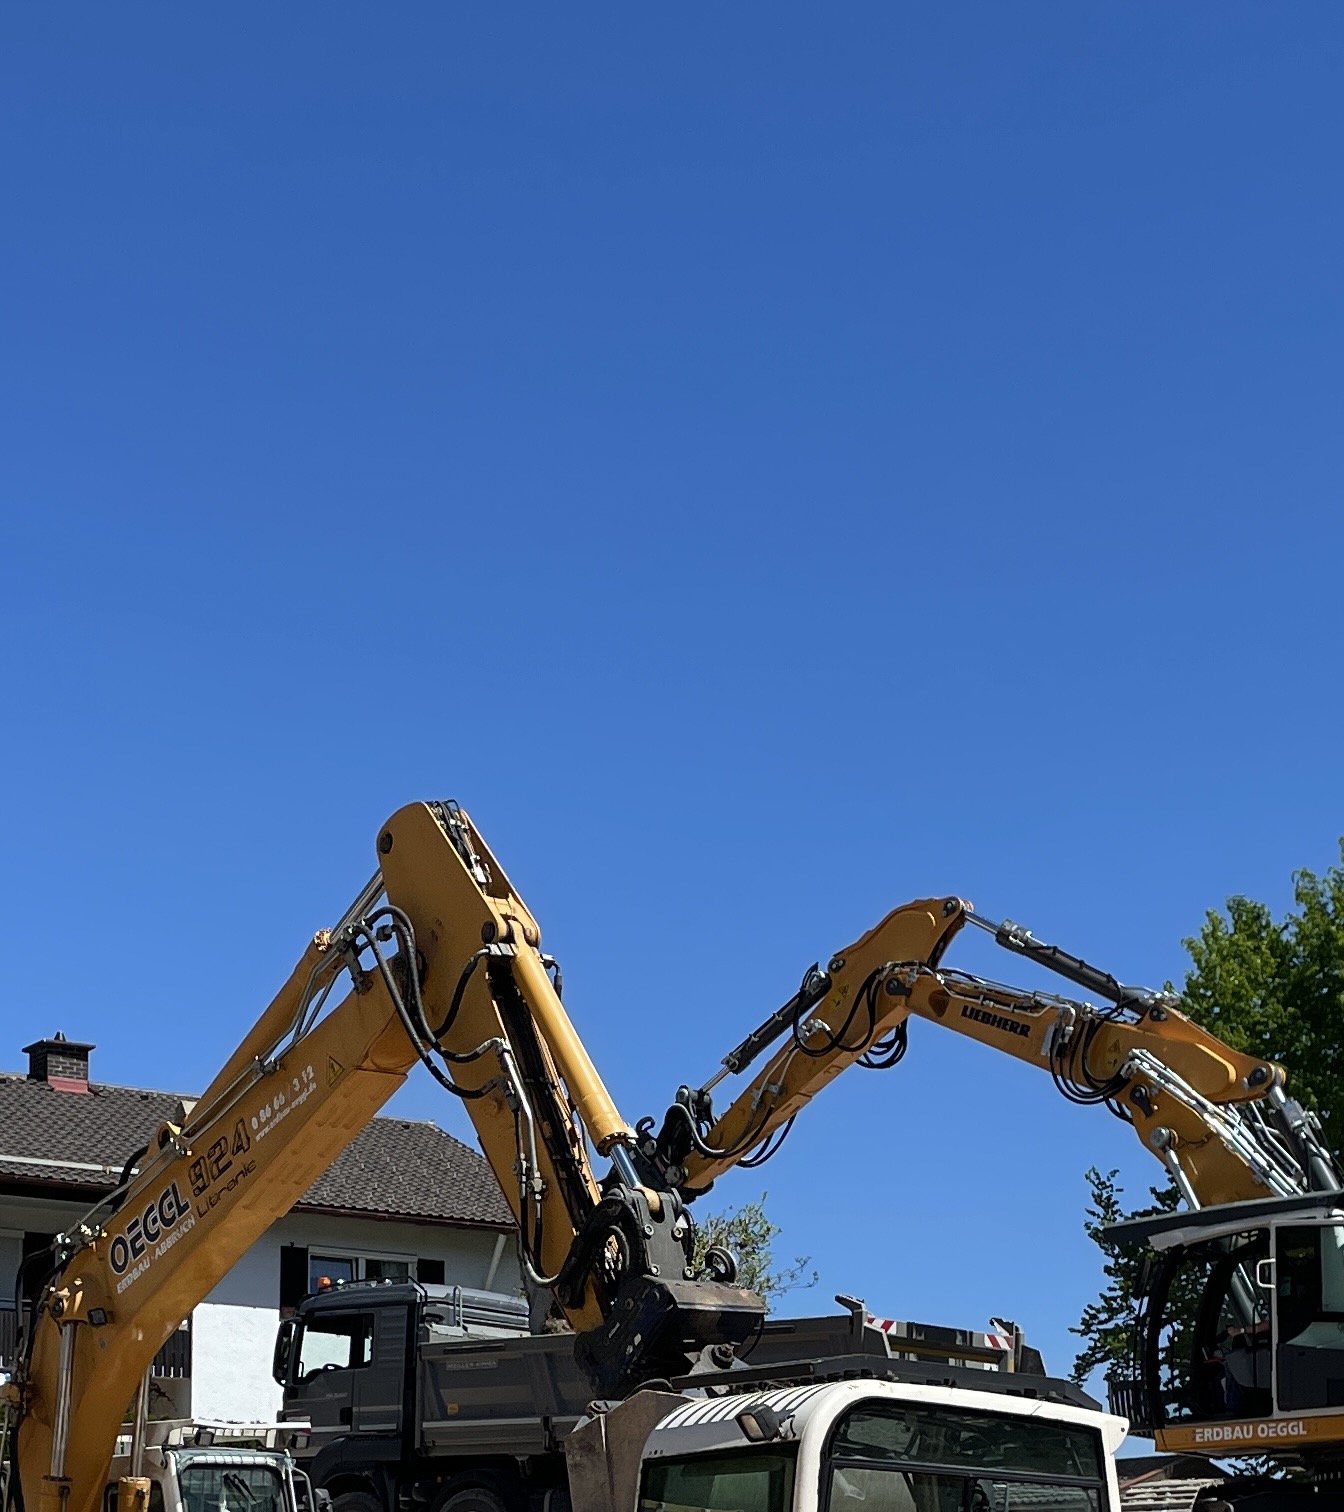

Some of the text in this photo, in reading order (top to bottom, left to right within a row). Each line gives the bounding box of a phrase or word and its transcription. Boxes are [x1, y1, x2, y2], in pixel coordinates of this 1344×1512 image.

[960, 1004, 1031, 1038] LIEBHERR
[188, 1118, 251, 1198] 924
[196, 1159, 256, 1219] Litronic
[110, 1180, 191, 1275] OEGGL
[1196, 1421, 1307, 1442] ERDBAU OEGGL
